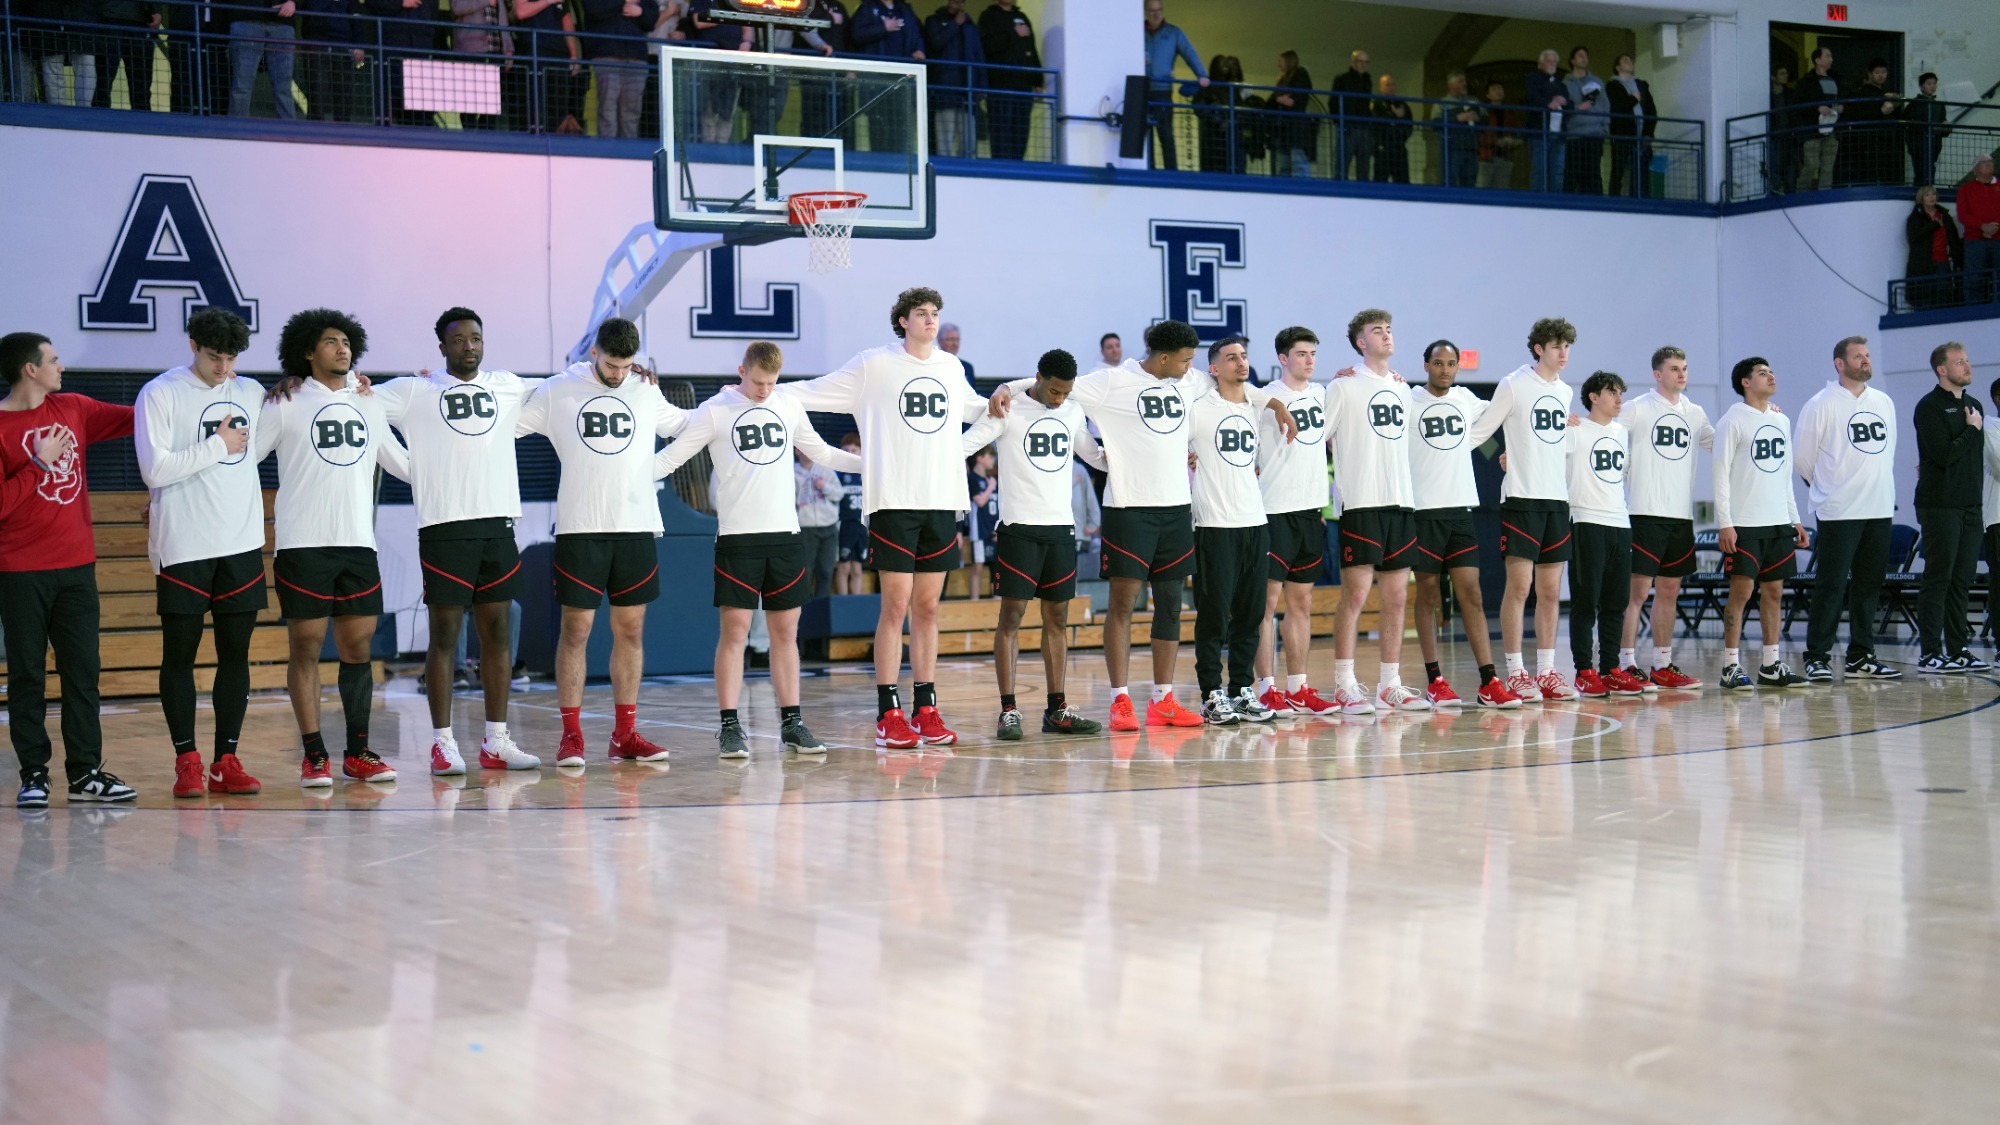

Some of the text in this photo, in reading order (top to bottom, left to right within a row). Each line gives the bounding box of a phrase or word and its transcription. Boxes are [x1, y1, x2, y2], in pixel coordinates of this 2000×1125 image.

[79, 173, 1247, 348] A L E
[635, 256, 659, 290] LEGACY
[444, 393, 494, 420] BC
[904, 393, 946, 417] BC
[1141, 396, 1183, 418] BC
[1371, 405, 1404, 426] BC
[582, 412, 631, 437] BC
[1290, 407, 1324, 431] BC
[1422, 416, 1463, 438] BC
[1534, 409, 1566, 430] BC
[316, 421, 366, 448] BC
[736, 423, 784, 451] BC
[1219, 430, 1255, 453] BC
[1654, 426, 1690, 448] BC
[1849, 422, 1887, 443] BC
[1028, 433, 1068, 457] BC
[1755, 438, 1785, 460] BC
[1593, 450, 1625, 470] BC
[1344, 546, 1353, 562] C
[1724, 556, 1733, 571] C
